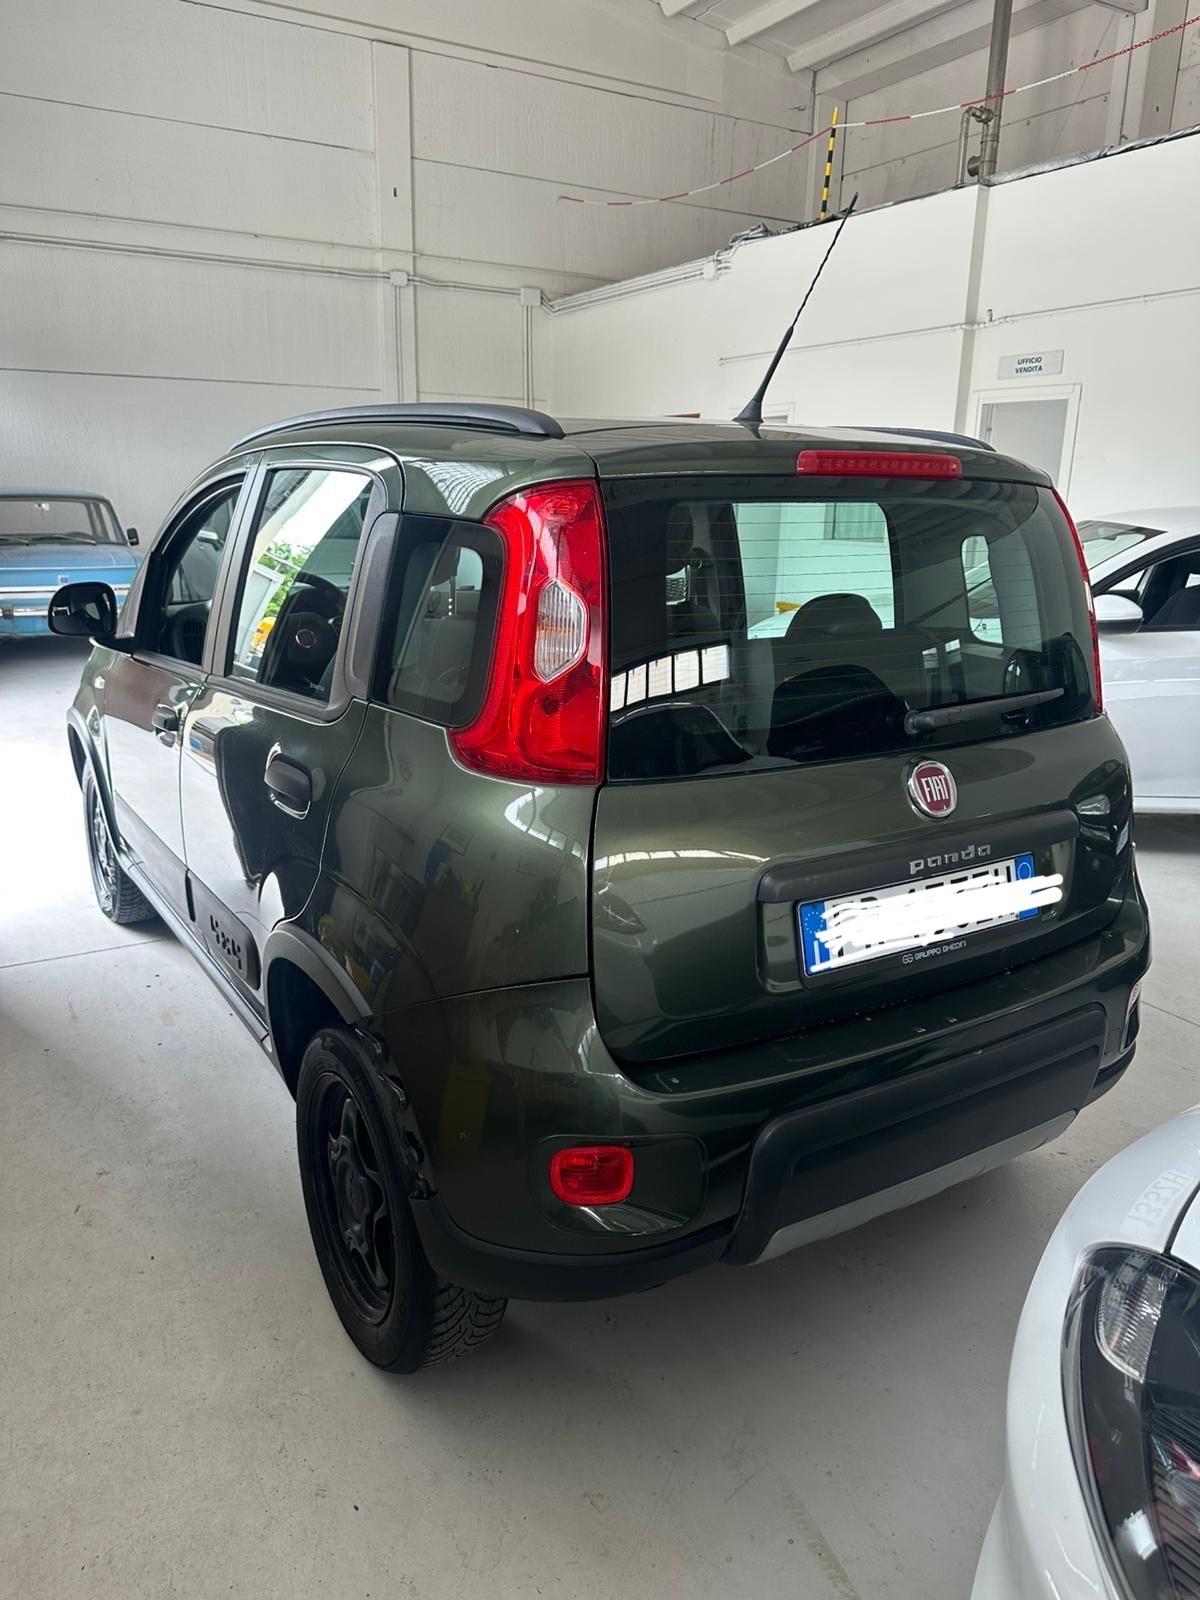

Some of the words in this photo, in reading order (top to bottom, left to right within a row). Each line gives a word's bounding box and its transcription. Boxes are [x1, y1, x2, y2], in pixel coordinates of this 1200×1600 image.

[1017, 356, 1043, 366] UFFICIO
[1015, 364, 1043, 374] VENDITA
[920, 774, 949, 803] FIAT
[909, 844, 991, 875] panda
[914, 947, 941, 960] GRUPPO
